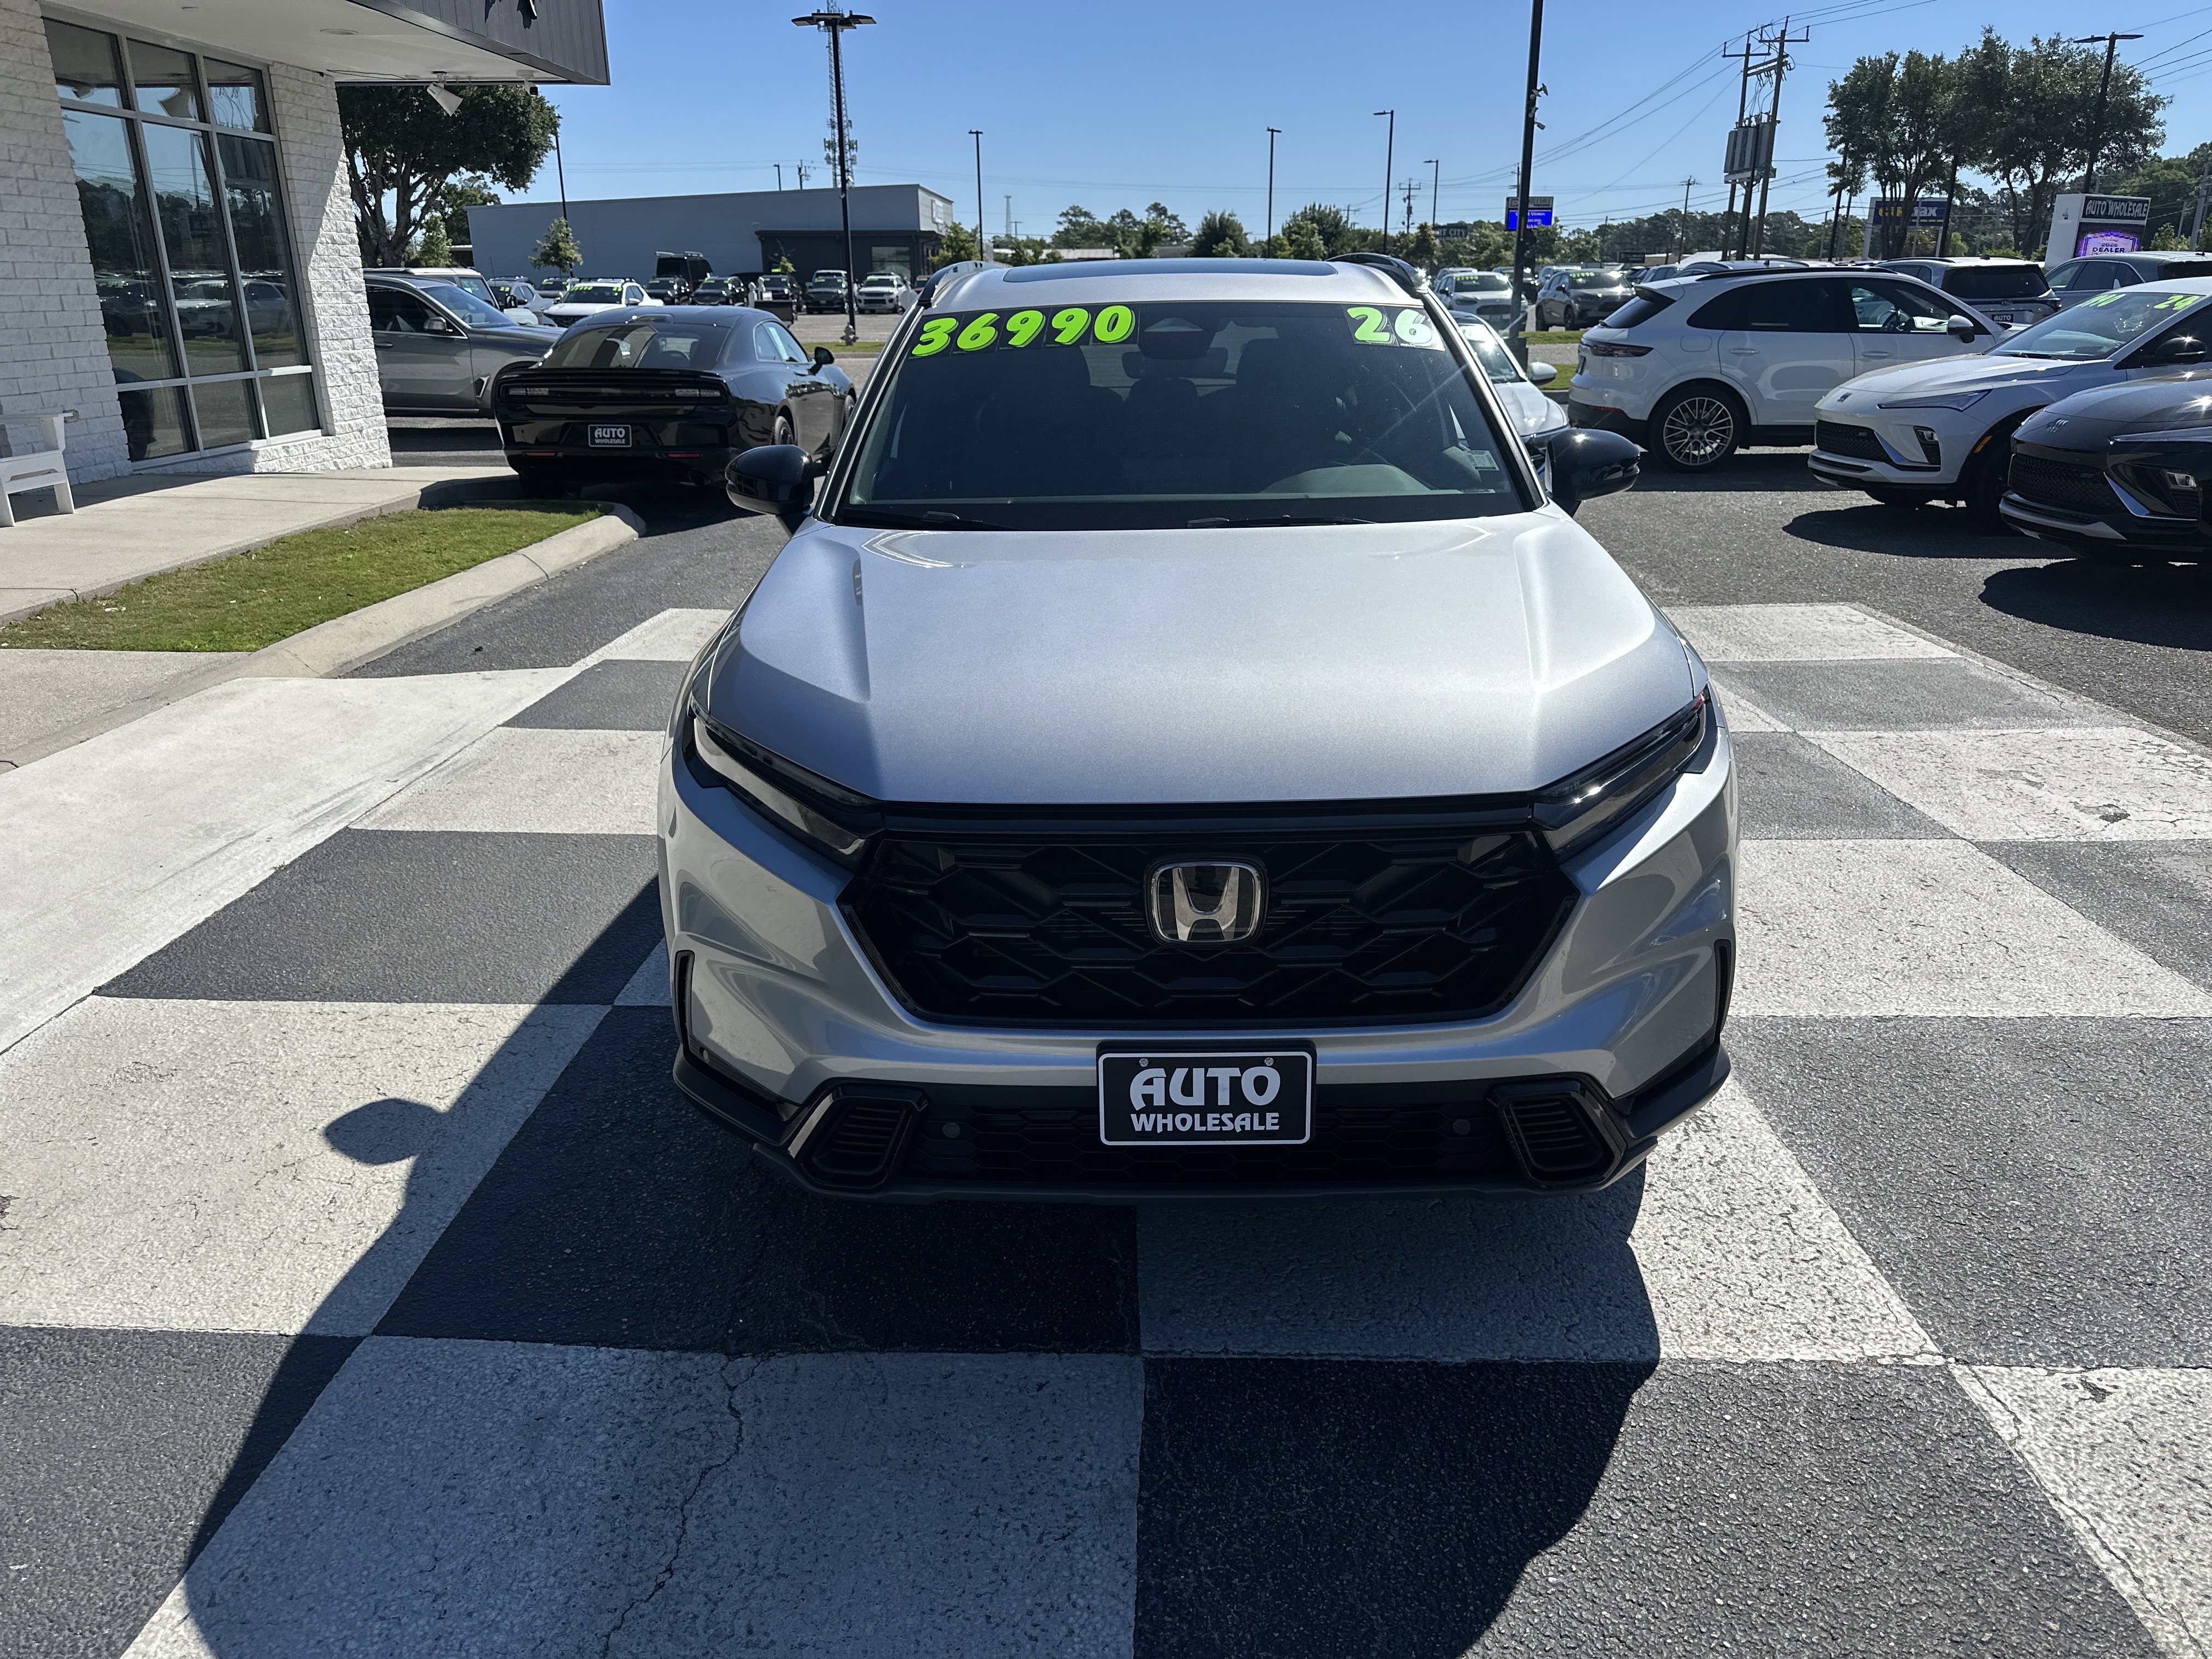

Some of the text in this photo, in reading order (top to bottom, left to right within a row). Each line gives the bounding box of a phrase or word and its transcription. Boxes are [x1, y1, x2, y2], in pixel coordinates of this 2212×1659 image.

[2086, 200, 2148, 218] AUTO WHOLESALE
[2153, 295, 2200, 311] 24
[911, 305, 1434, 357] 36990 26
[595, 428, 625, 438] AUTO
[1130, 1066, 1280, 1110] AUTO
[1131, 1113, 1280, 1133] WHOLESALE
